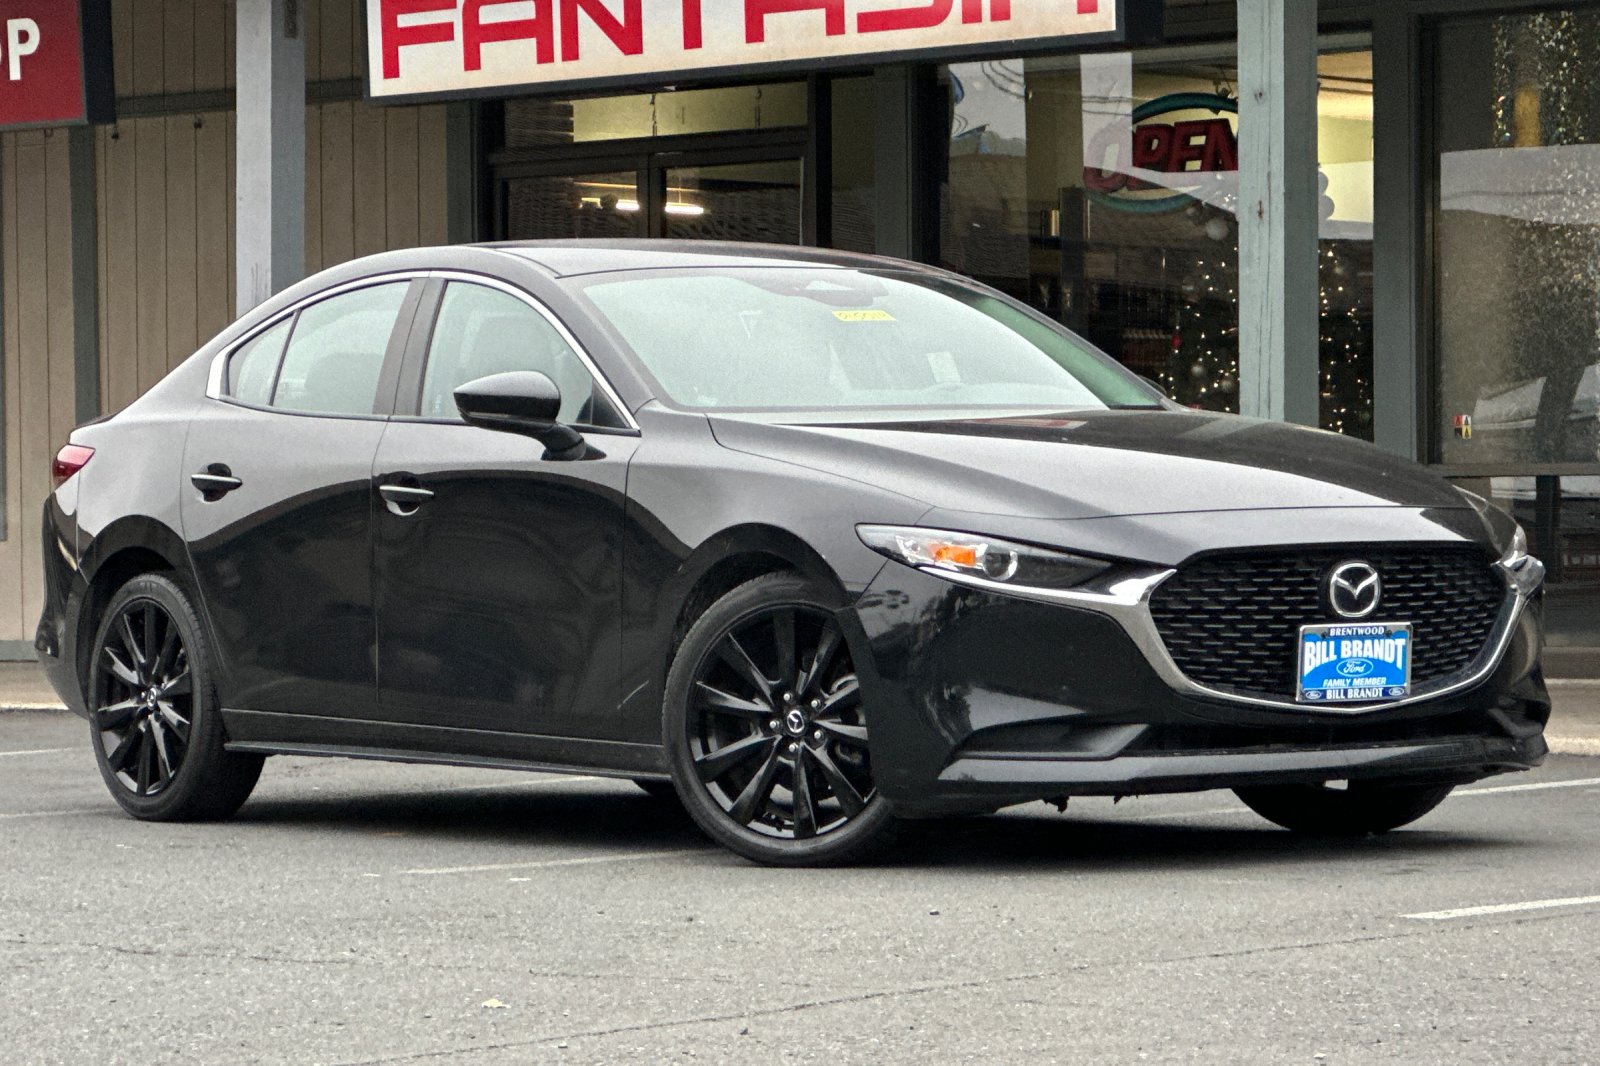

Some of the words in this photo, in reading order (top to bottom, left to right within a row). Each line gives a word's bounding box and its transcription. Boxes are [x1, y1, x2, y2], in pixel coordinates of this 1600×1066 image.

[380, 0, 1098, 79] FANTA
[1329, 626, 1385, 637] BRENTWOOD
[1304, 640, 1337, 677] BILL
[1341, 638, 1406, 670] BRANDT
[1343, 660, 1367, 674] Ford
[1323, 679, 1351, 688] FAMILY
[1352, 677, 1387, 686] MEMBER
[1326, 688, 1346, 699] BILL
[1347, 687, 1384, 699] BRANDT
